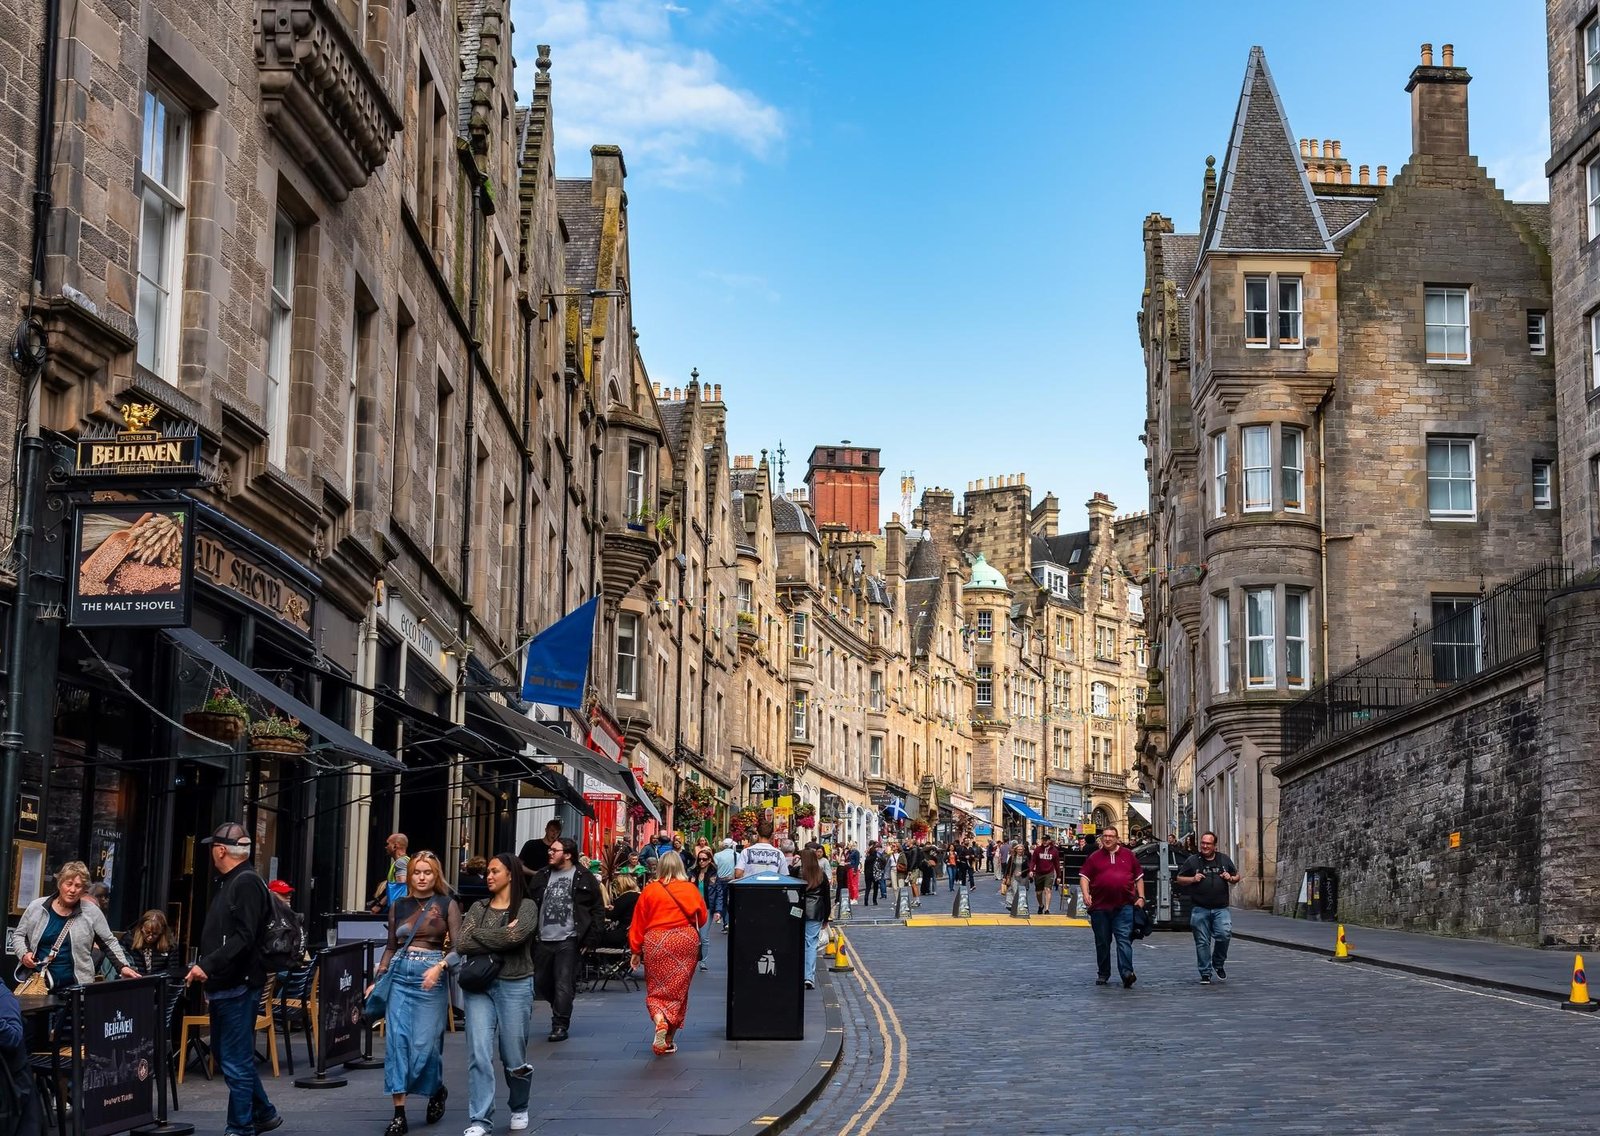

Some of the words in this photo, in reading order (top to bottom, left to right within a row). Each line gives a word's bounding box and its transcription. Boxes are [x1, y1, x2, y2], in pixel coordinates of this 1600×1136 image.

[119, 434, 153, 442] DUNBAR
[91, 441, 183, 467] BELHAVEN
[195, 538, 225, 578] ALT
[230, 558, 284, 615] SHOVEL
[82, 602, 102, 611] THE
[104, 602, 133, 611] MALT
[134, 601, 176, 610] SHOVEL
[401, 613, 417, 643] ecco
[418, 626, 433, 657] vino
[104, 1018, 133, 1039] BELHAVEN
